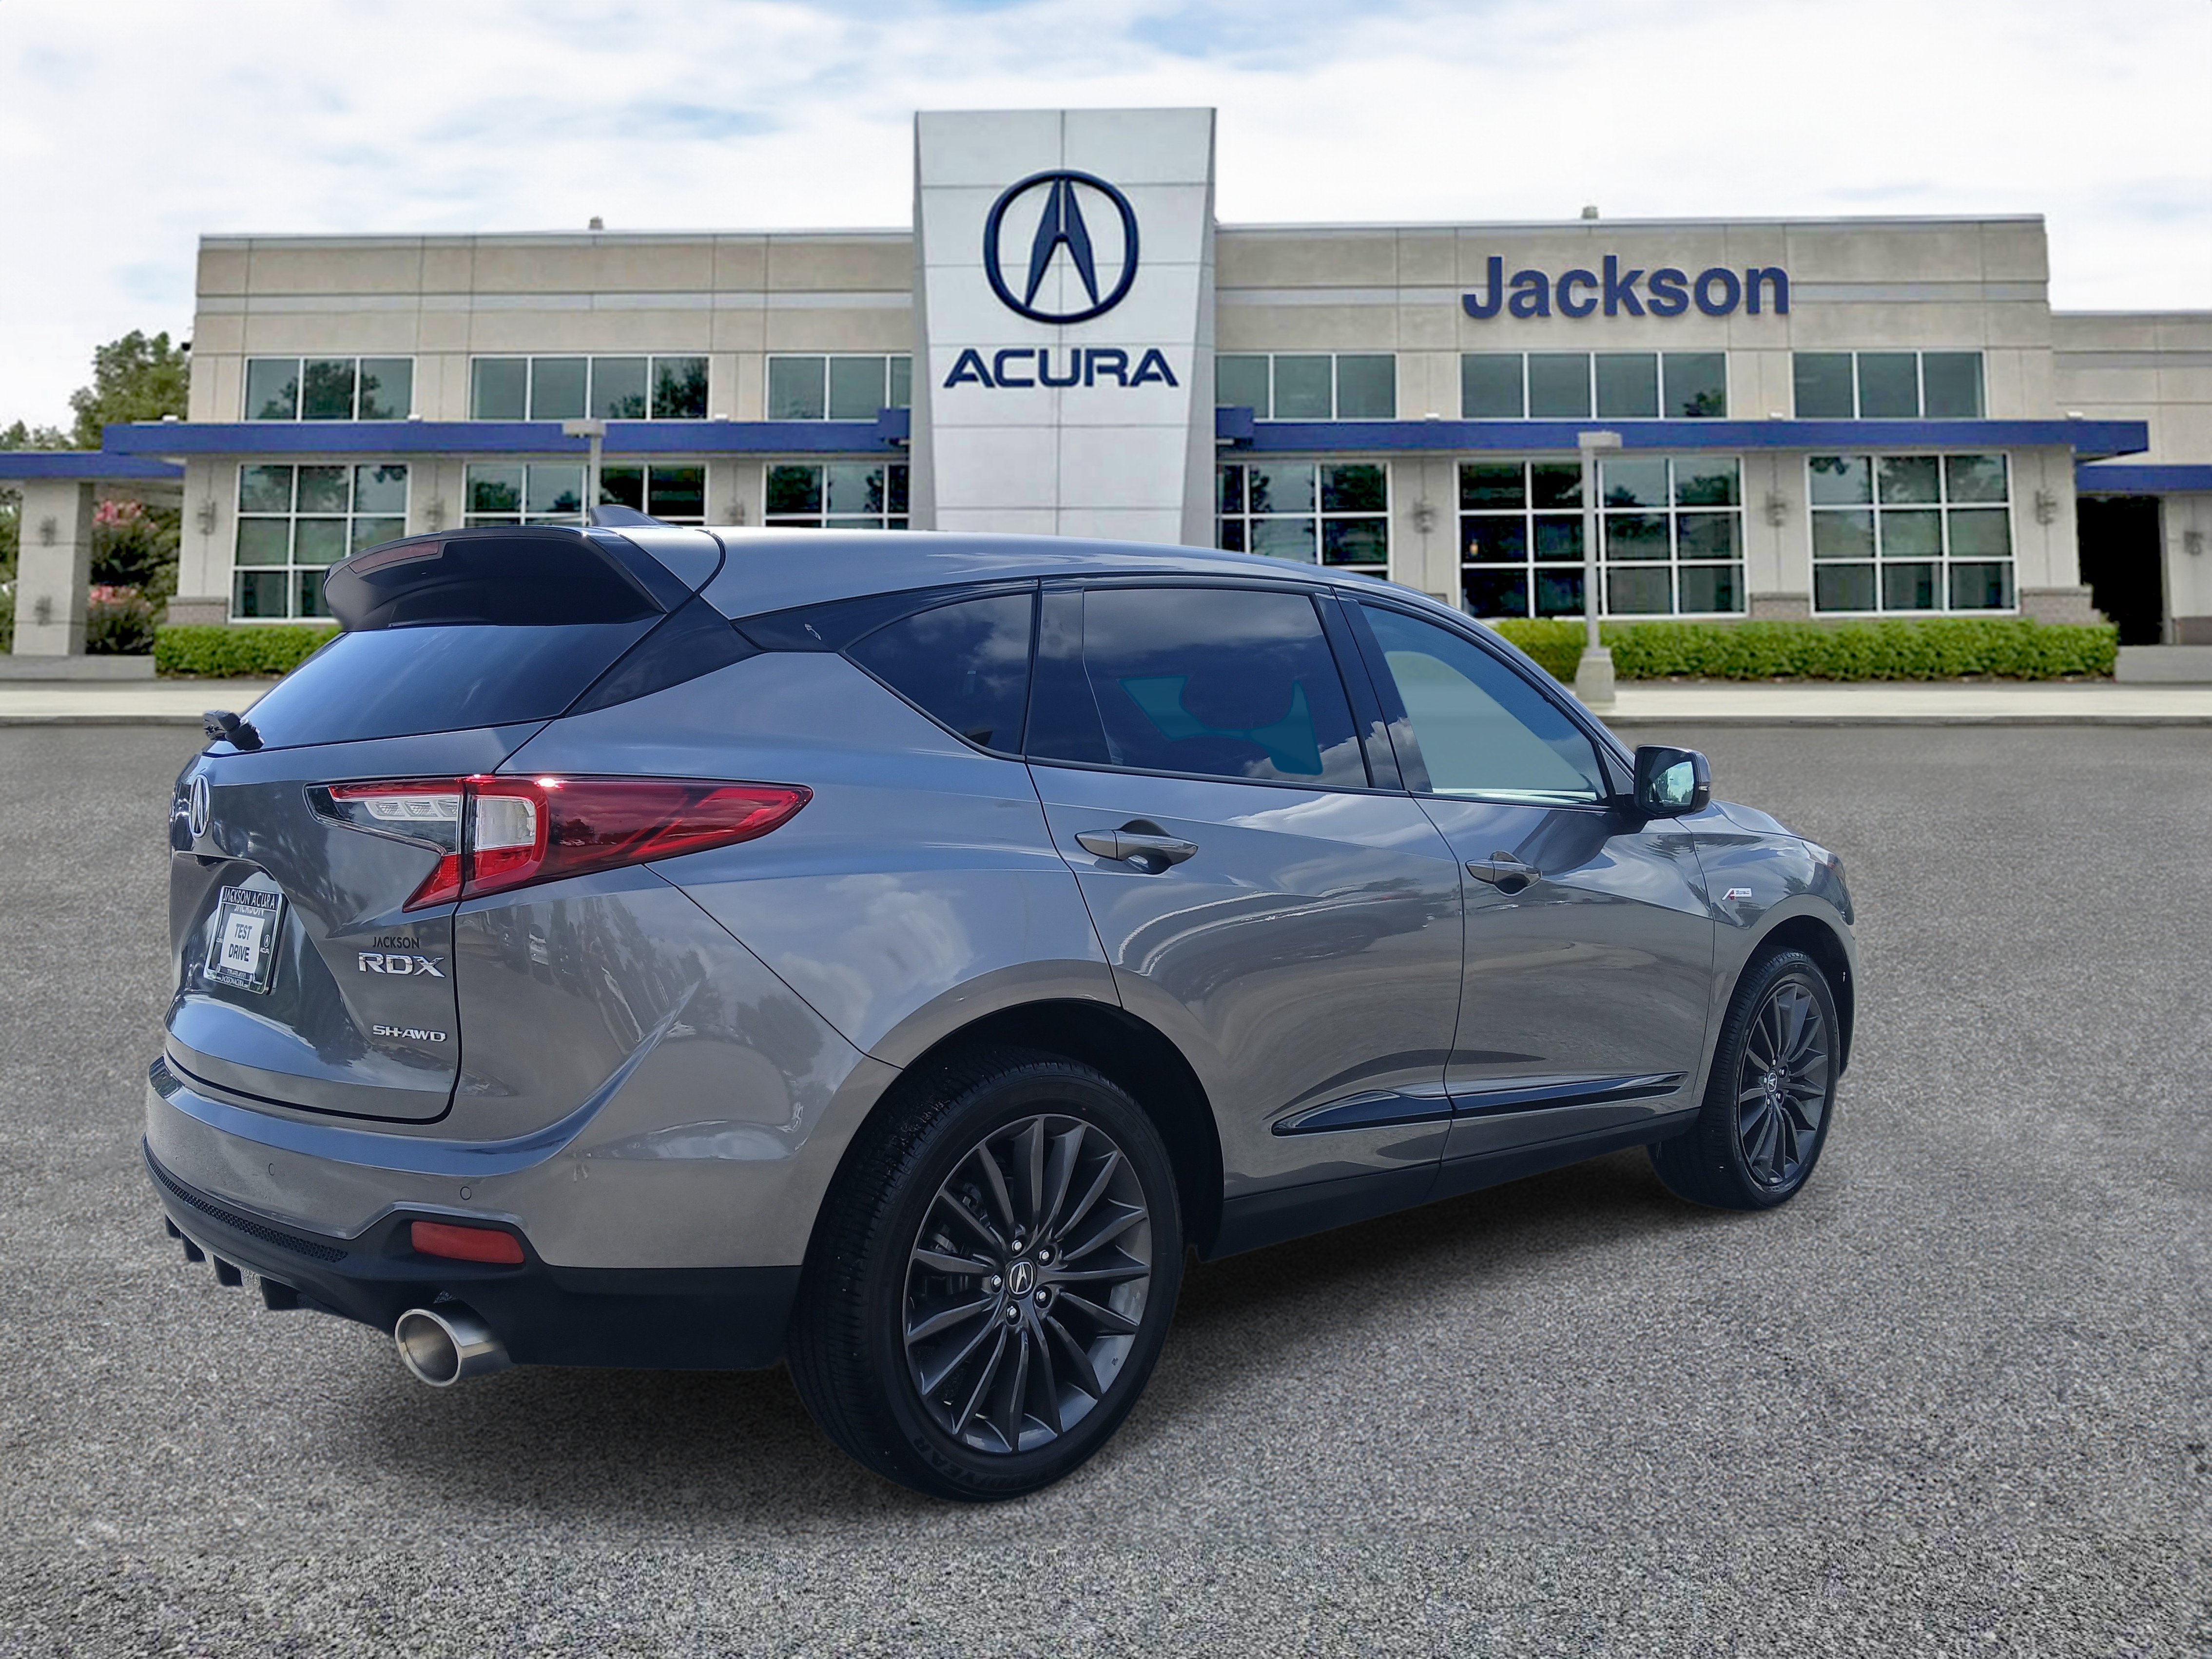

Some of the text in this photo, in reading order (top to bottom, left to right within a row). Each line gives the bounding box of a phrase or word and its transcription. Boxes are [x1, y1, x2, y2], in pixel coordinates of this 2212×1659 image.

[1462, 255, 1790, 319] Jackson
[943, 348, 1180, 388] ACURA
[223, 887, 275, 909] JACKSON ACURA
[234, 923, 253, 941] TEST
[228, 943, 250, 962] DRIVE
[372, 936, 421, 949] JACKSON
[358, 952, 446, 978] RDX
[372, 1024, 446, 1042] SH-AWD
